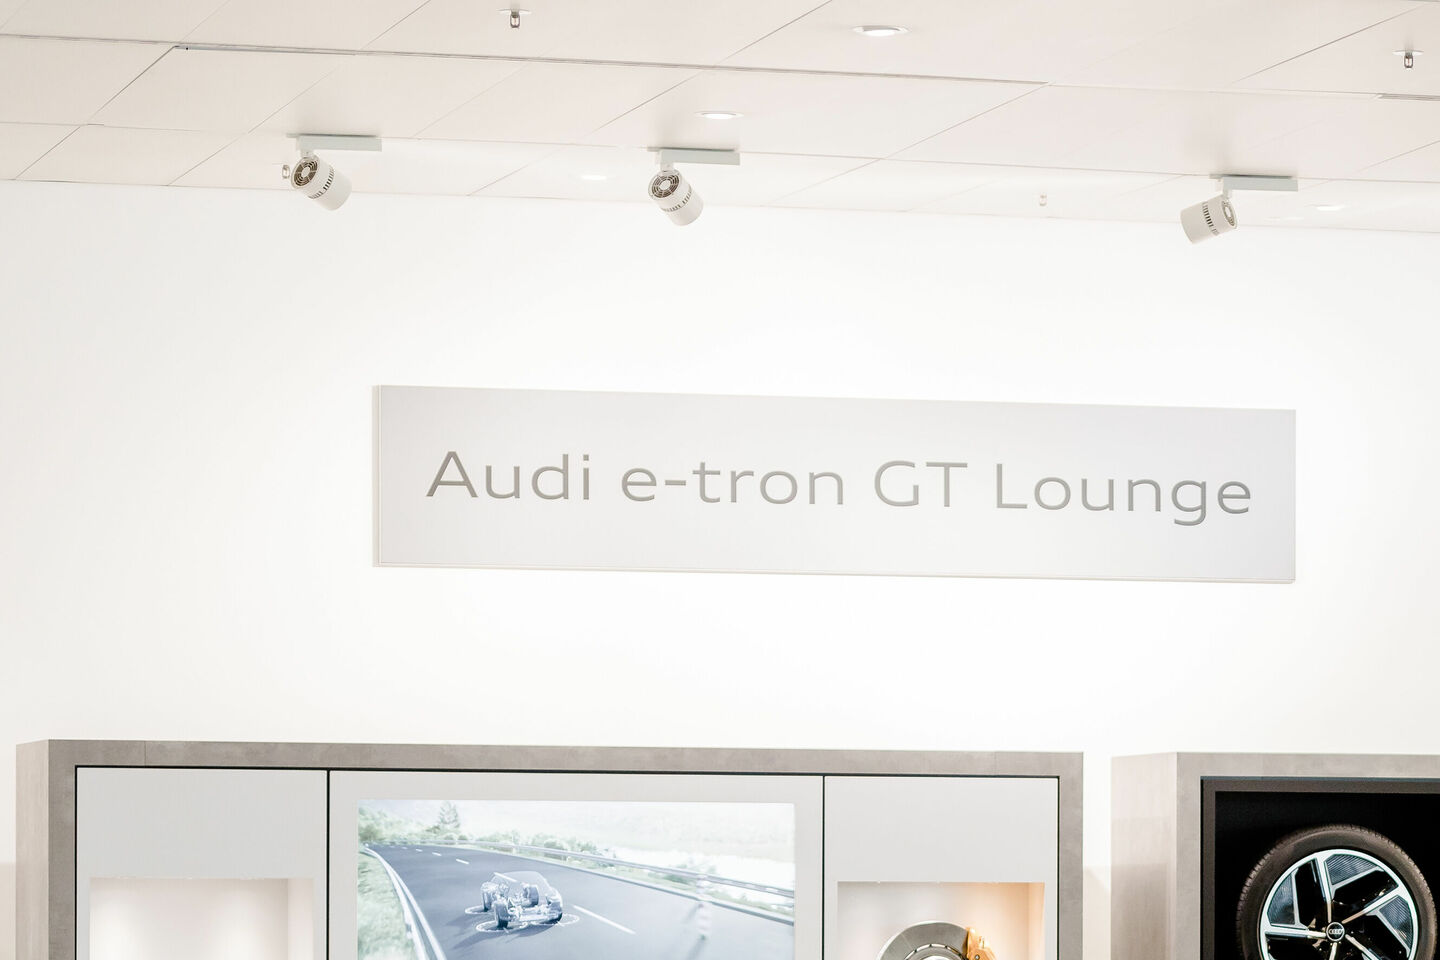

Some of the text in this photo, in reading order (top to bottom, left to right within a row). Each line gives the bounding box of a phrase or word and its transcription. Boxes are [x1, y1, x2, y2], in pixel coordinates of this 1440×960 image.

[426, 451, 1251, 526] Audi e-tron GT Lounge
